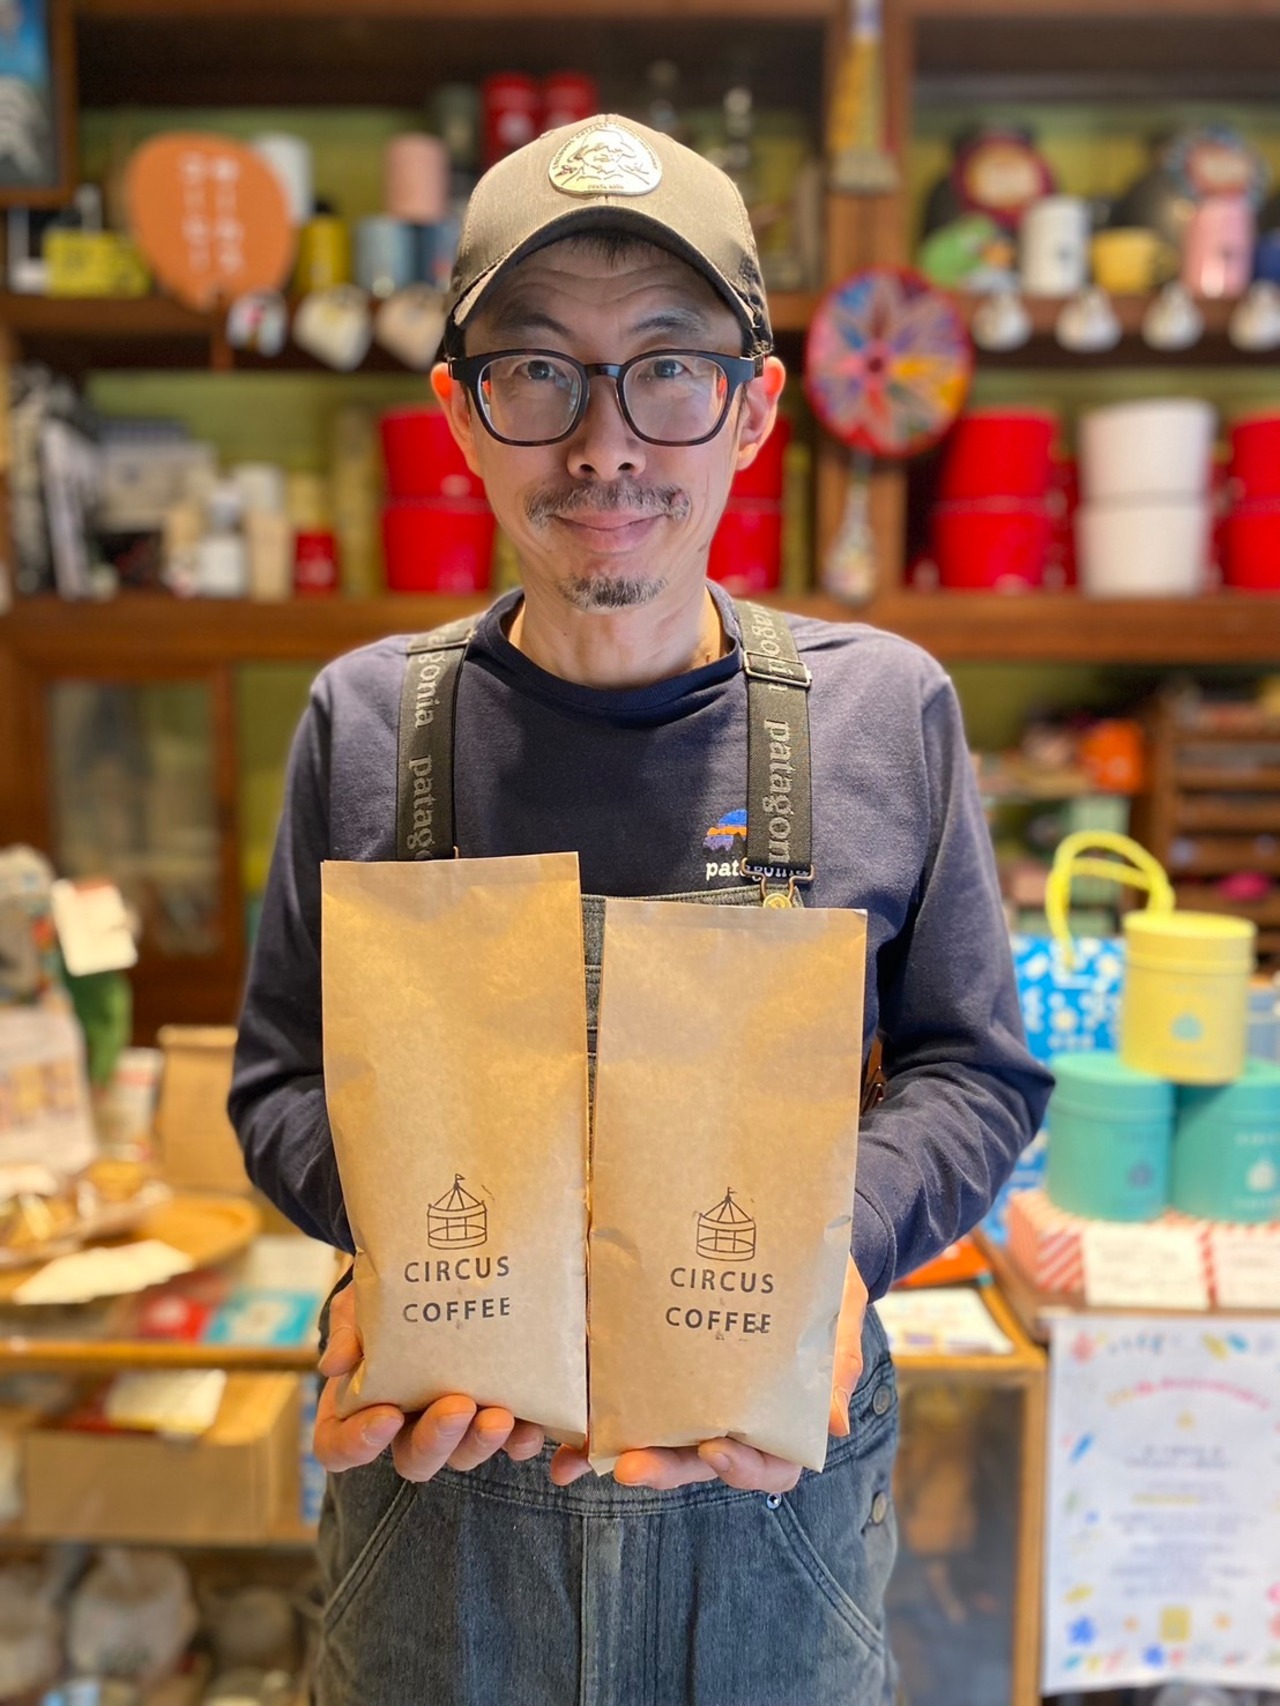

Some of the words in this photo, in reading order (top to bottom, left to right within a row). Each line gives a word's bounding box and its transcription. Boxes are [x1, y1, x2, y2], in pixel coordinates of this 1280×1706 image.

[404, 1256, 510, 1283] CIRCUS
[670, 1267, 774, 1294] CIRCUS
[402, 1297, 511, 1323] COFFEE
[665, 1307, 771, 1334] COFFEE
